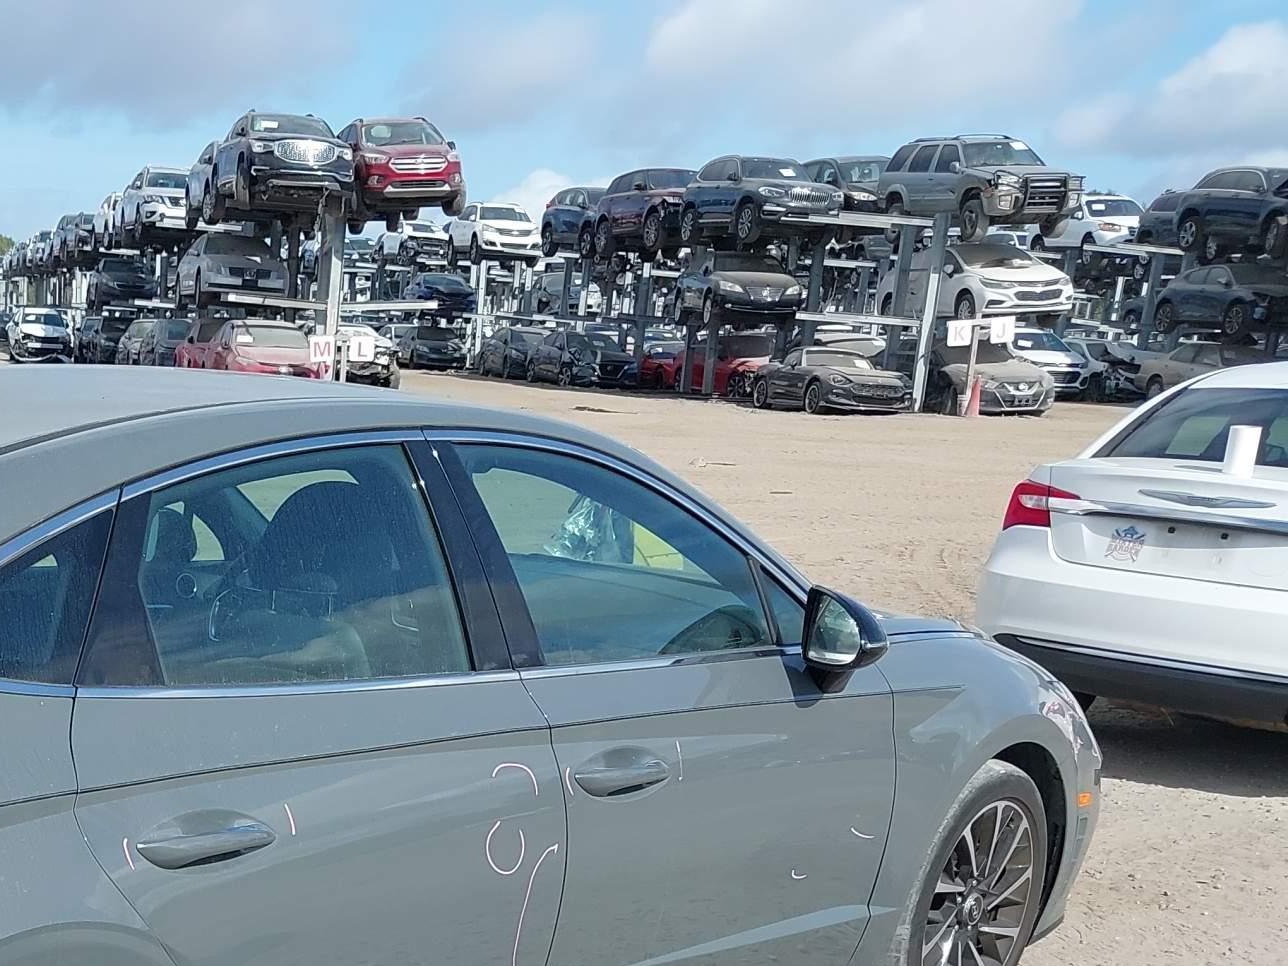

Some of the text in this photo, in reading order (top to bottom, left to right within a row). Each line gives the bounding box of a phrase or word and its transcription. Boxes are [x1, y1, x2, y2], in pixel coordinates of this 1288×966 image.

[953, 326, 965, 342] K
[996, 323, 1006, 338] J
[313, 341, 331, 358] M
[357, 342, 368, 357] L
